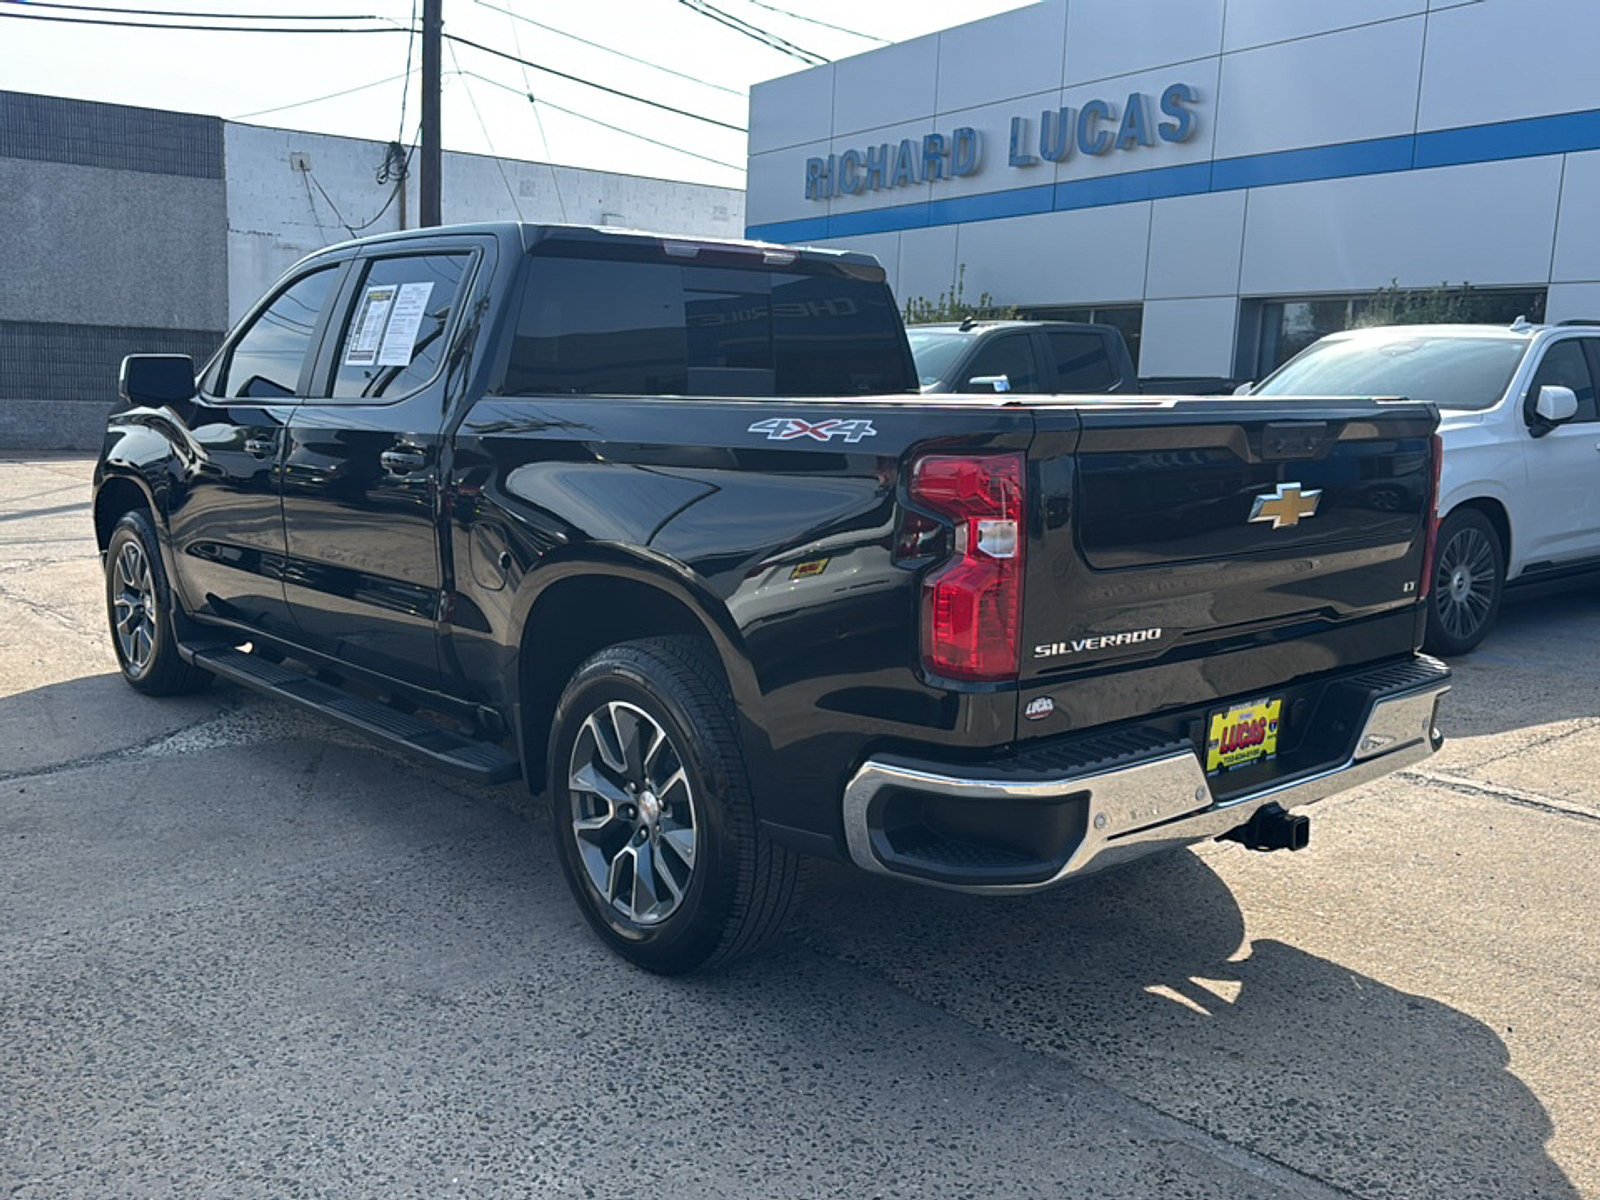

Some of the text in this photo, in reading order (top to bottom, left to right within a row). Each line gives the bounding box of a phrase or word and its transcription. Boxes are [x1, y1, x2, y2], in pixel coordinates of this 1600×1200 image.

[805, 83, 1198, 200] RICHARD LUCAS
[1033, 628, 1162, 658] SILVERADO
[1220, 716, 1267, 754] LUCAS
